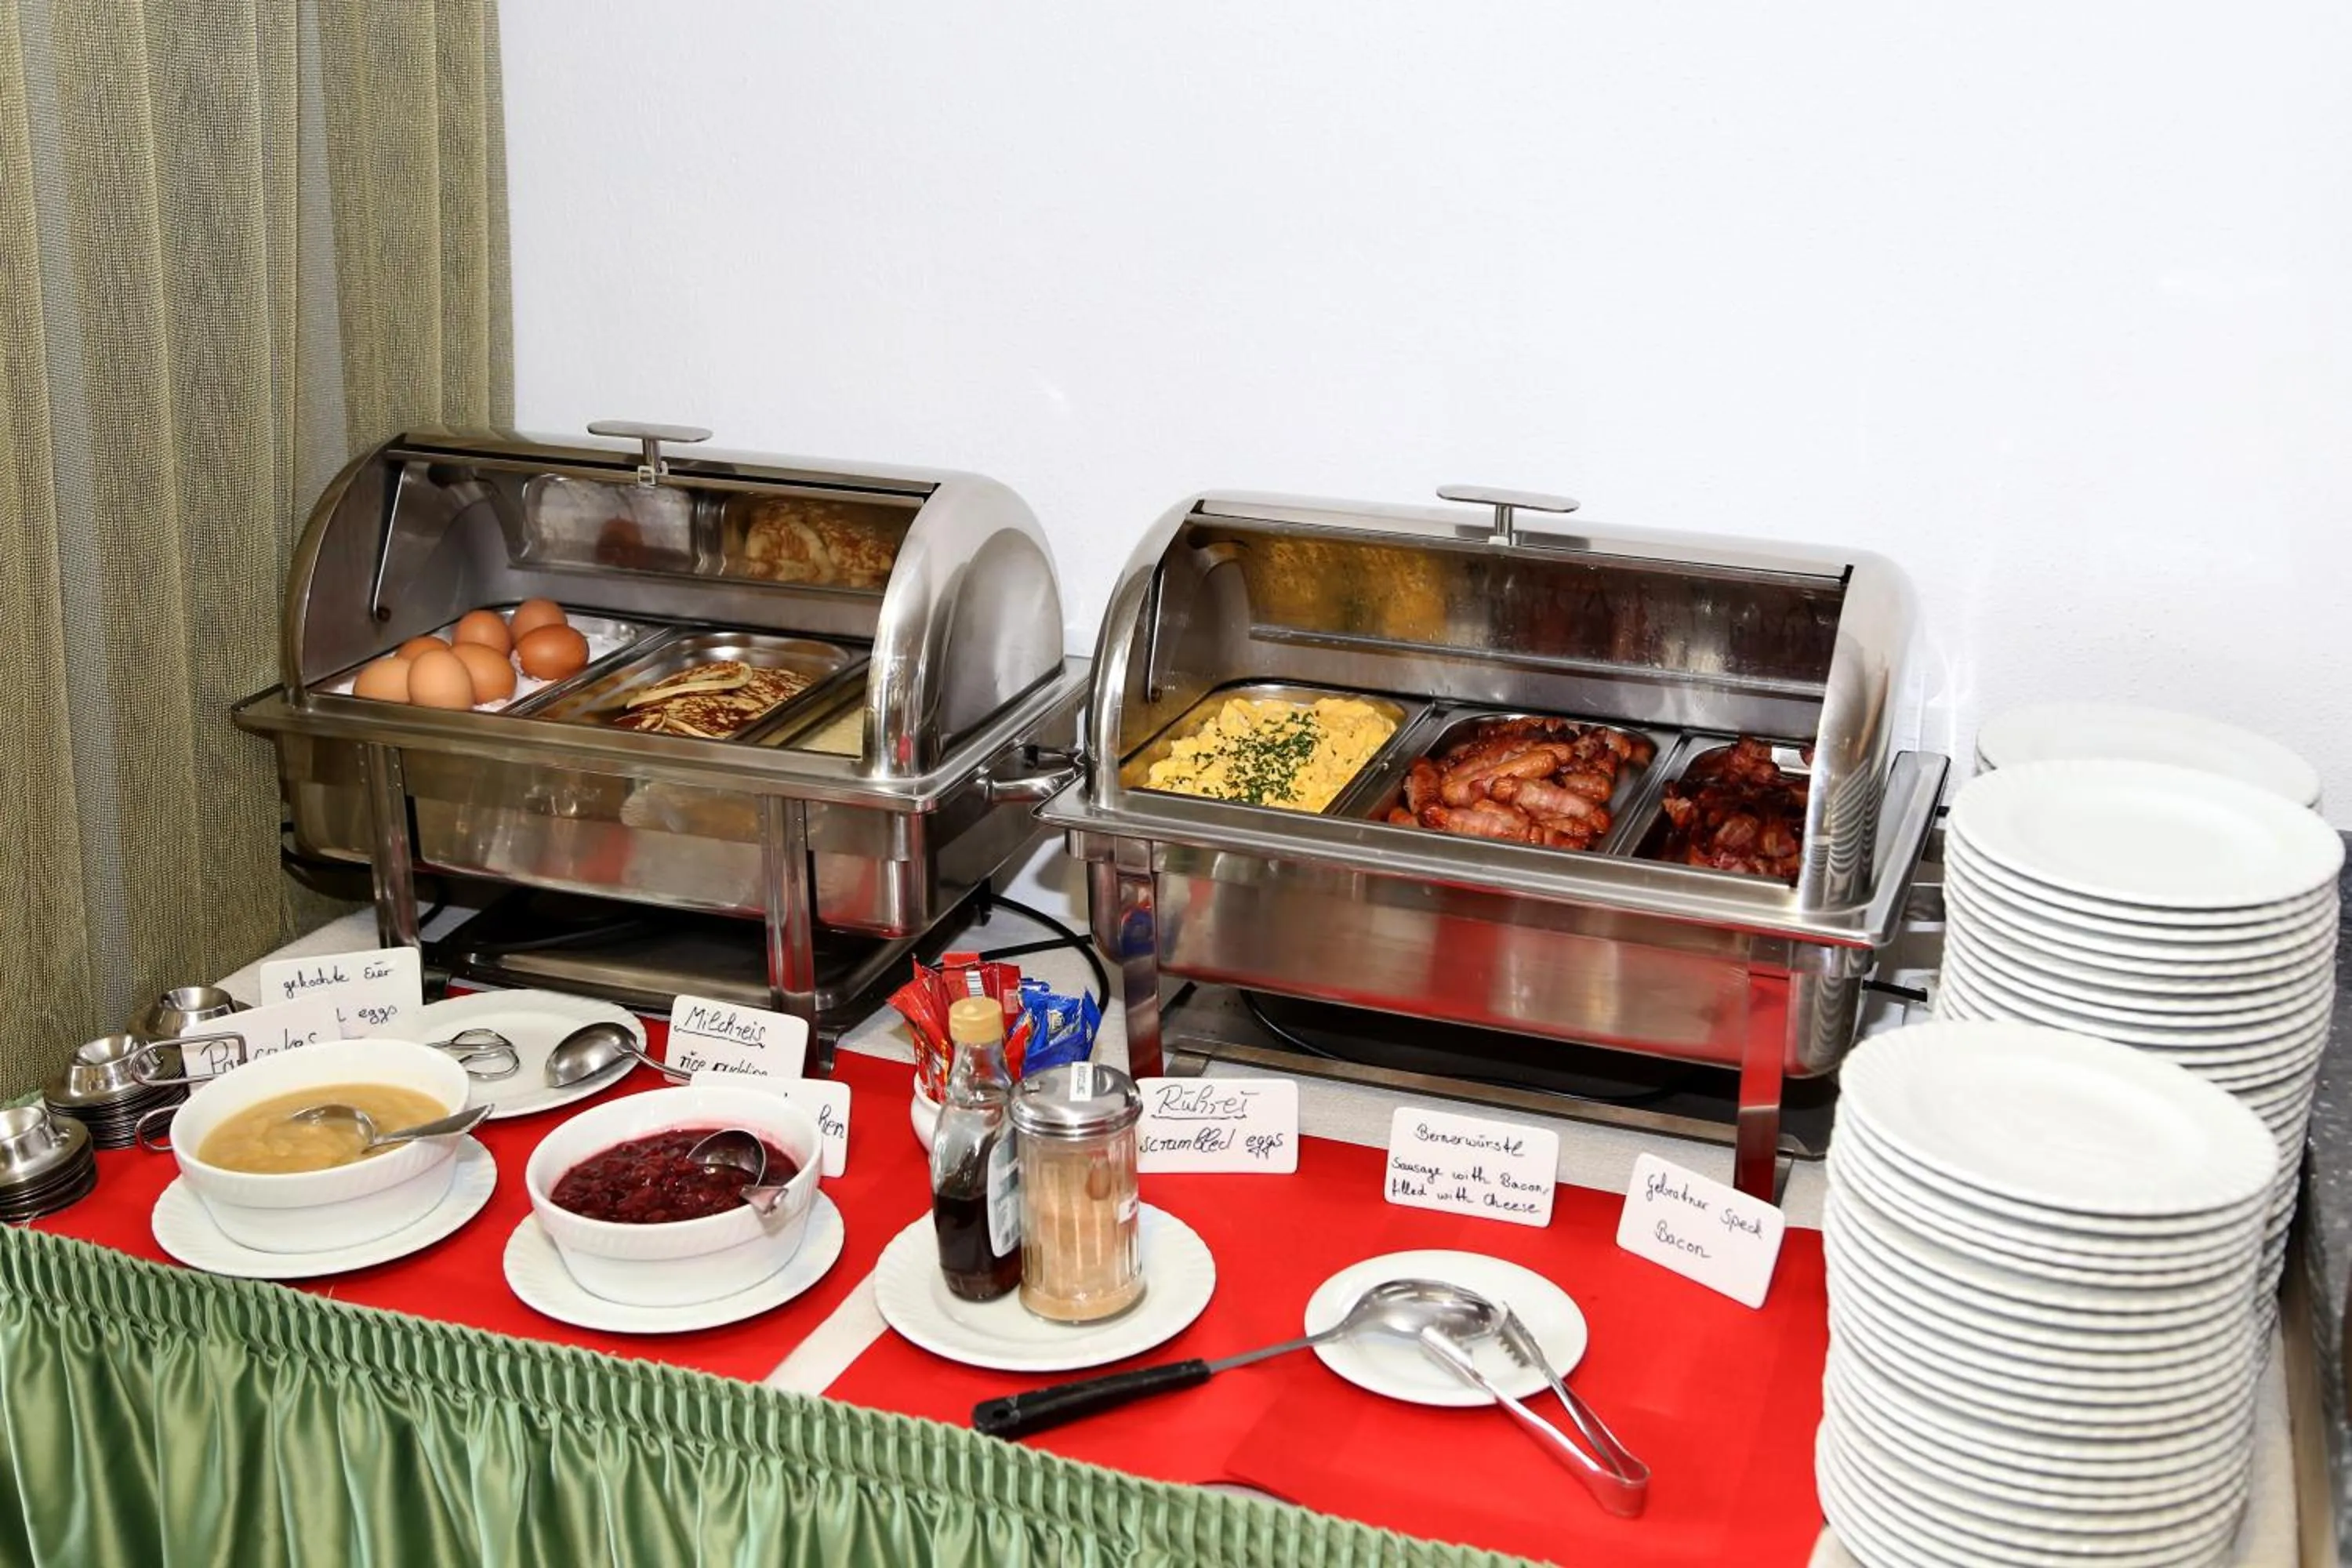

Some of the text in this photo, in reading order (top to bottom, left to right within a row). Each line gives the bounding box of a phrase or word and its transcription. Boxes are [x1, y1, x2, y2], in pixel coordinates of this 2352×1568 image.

[363, 961, 394, 979] Eier
[358, 1004, 398, 1025] eggs
[684, 1006, 766, 1043] Milchreis
[680, 1050, 706, 1072] rice
[1156, 1084, 1260, 1114] Rührei
[1139, 1127, 1284, 1160] scrambled eggs
[1392, 1156, 1443, 1185] Sausage
[1452, 1166, 1491, 1185] with
[1392, 1178, 1541, 1214] filled with Cheese
[1654, 1218, 1712, 1259] Bacon
[1719, 1207, 1763, 1240] Speck
